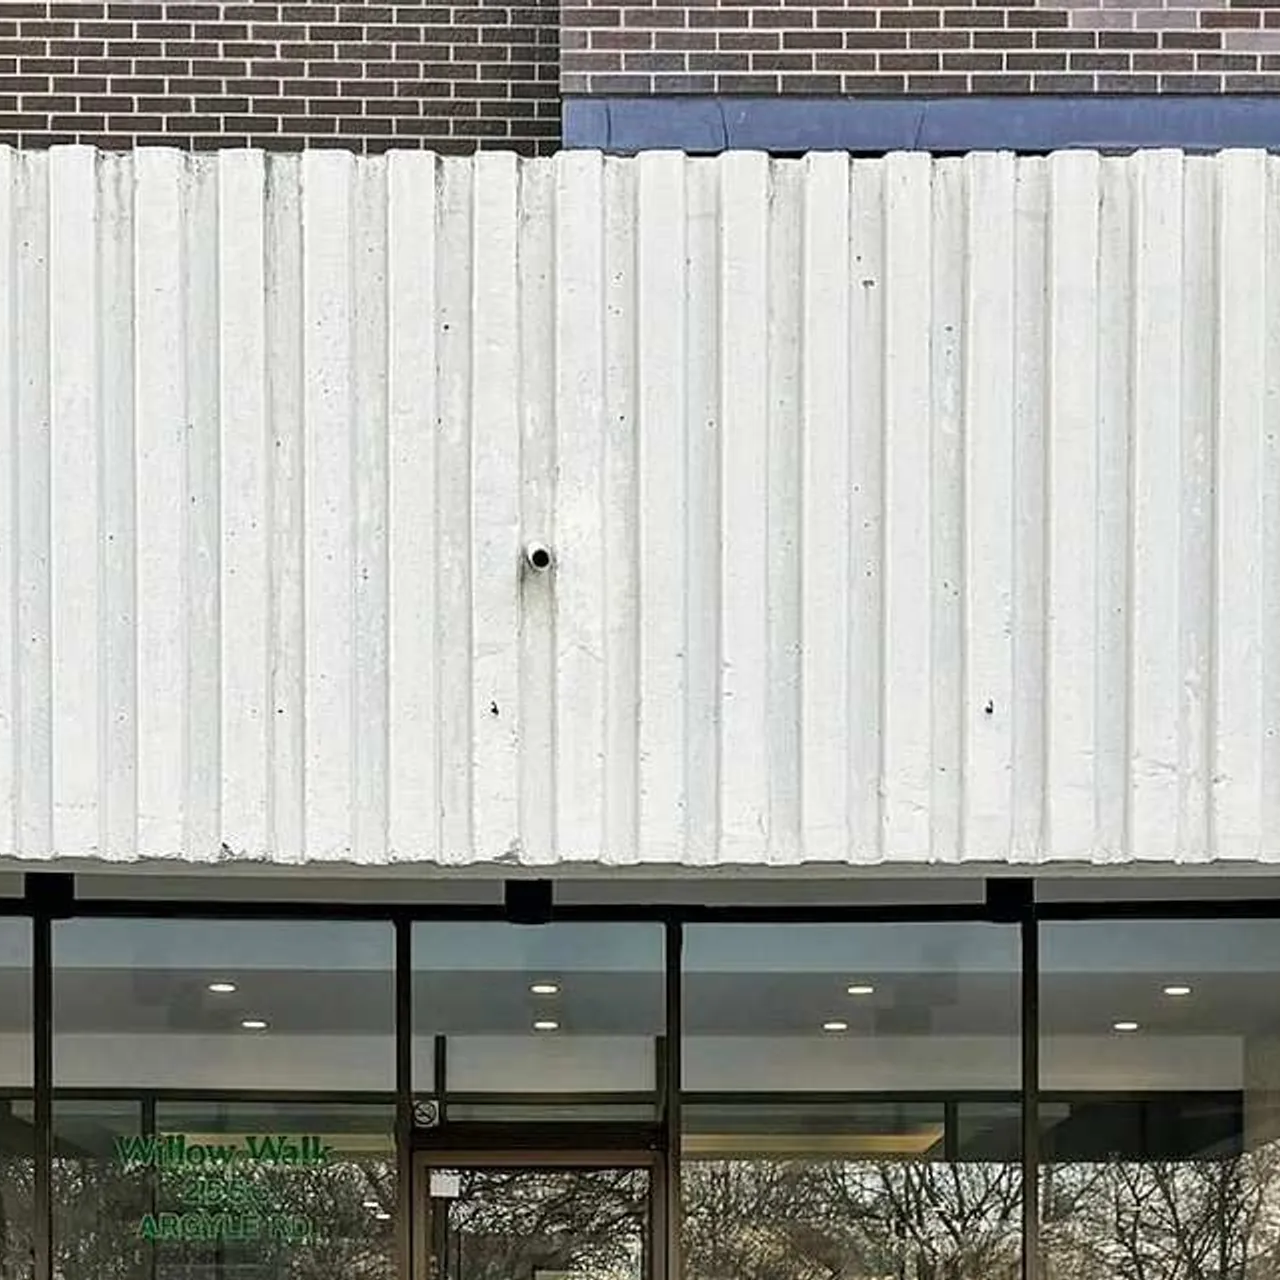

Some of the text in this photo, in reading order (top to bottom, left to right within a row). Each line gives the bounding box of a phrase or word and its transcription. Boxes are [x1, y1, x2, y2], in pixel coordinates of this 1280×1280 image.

[113, 1134, 333, 1167] Willow Walk
[139, 1212, 261, 1241] ARGYLE
